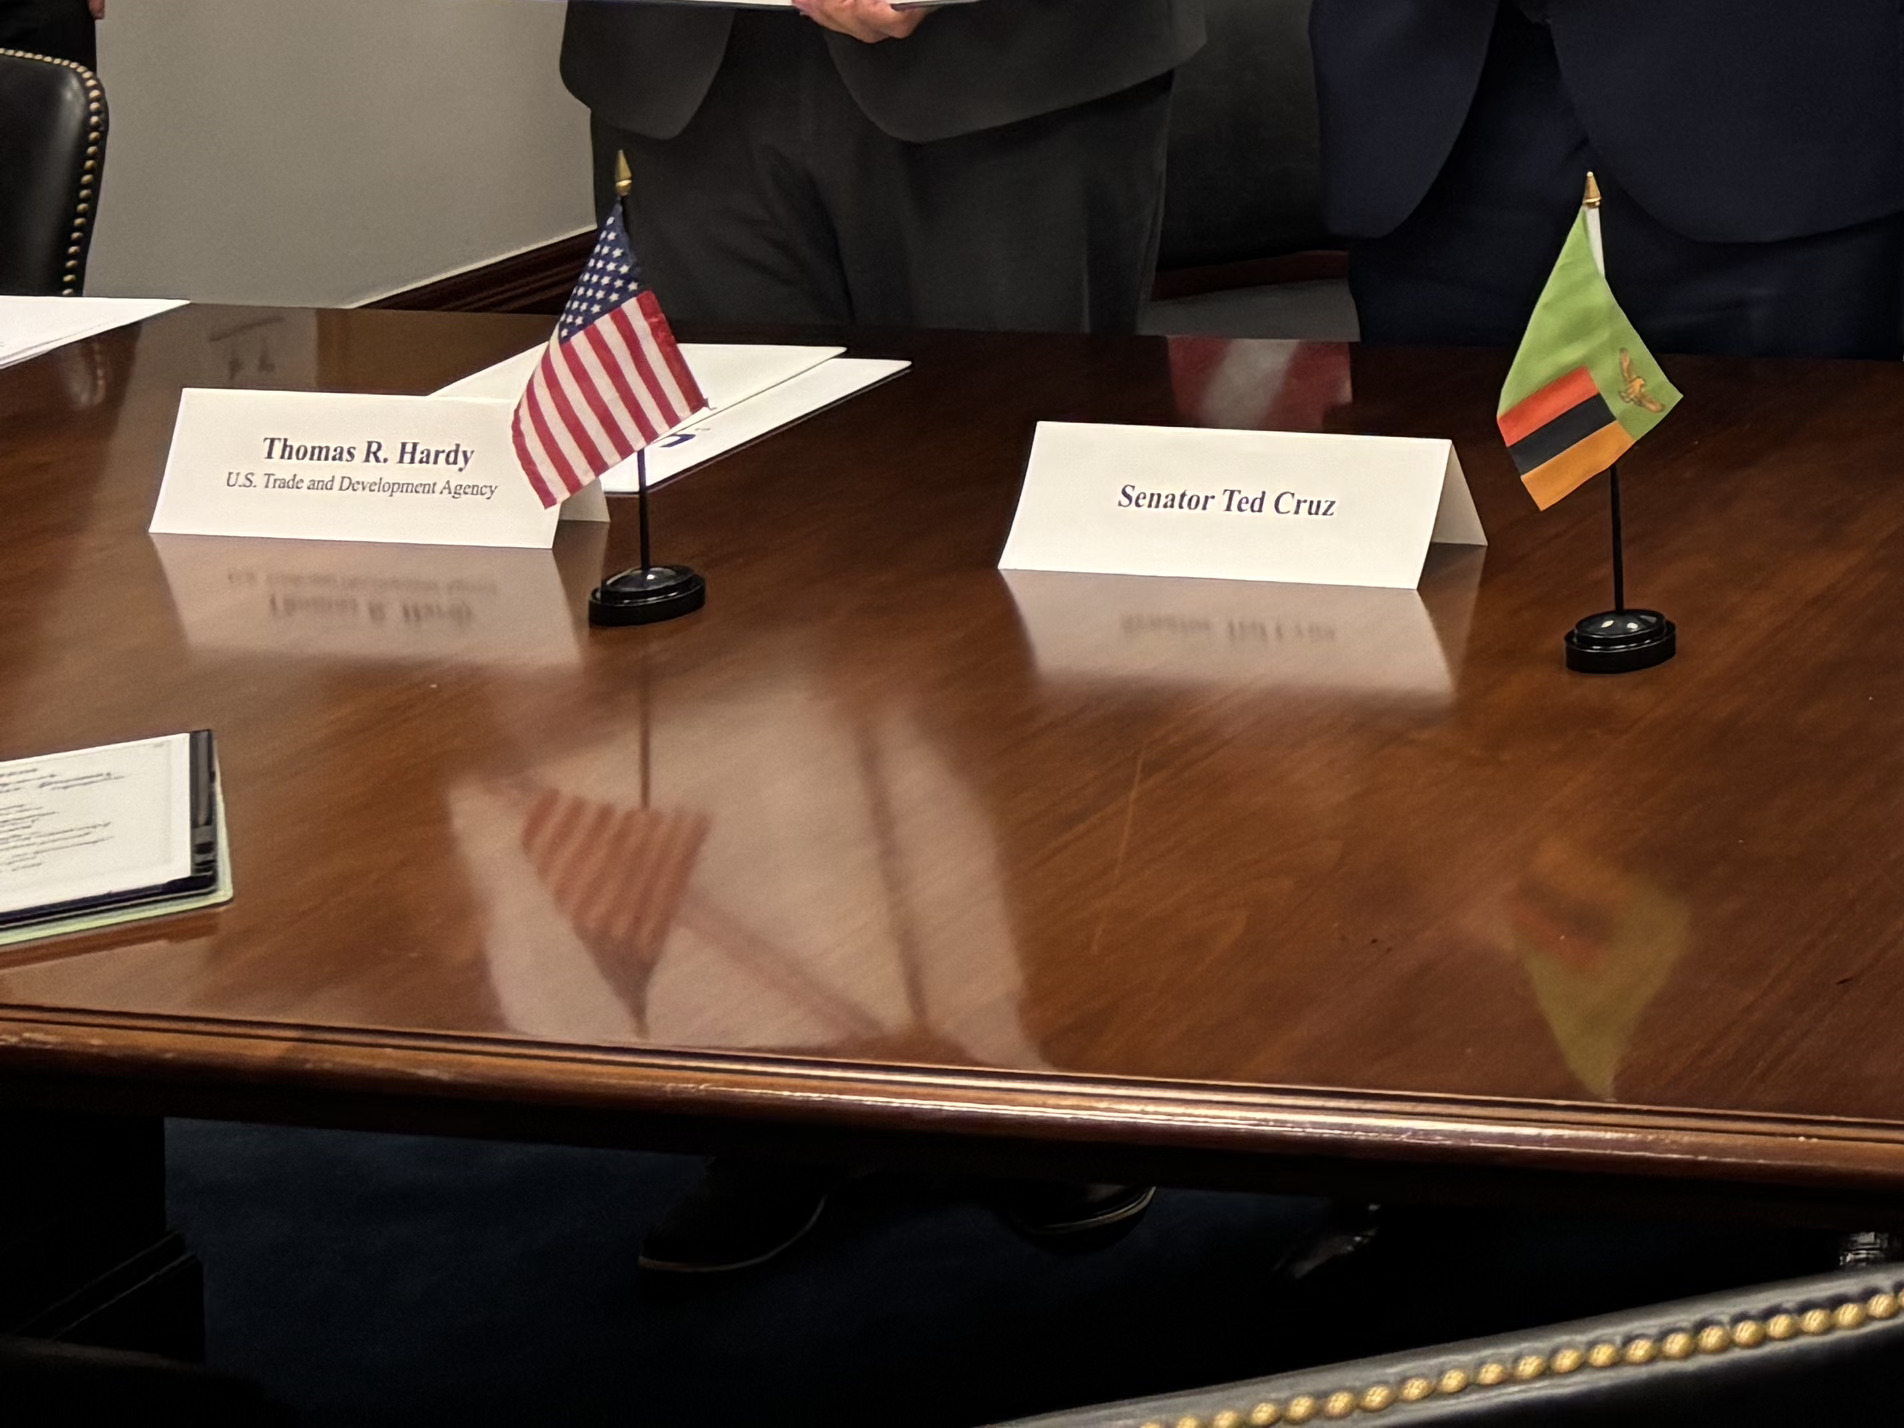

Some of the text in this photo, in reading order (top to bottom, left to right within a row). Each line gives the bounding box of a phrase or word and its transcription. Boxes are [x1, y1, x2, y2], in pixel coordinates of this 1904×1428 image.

[263, 437, 475, 473] Thomas R. Hardy
[226, 471, 498, 501] U.S. Trade and Development Agency
[1117, 484, 1337, 518] Senator Ted Cruz
